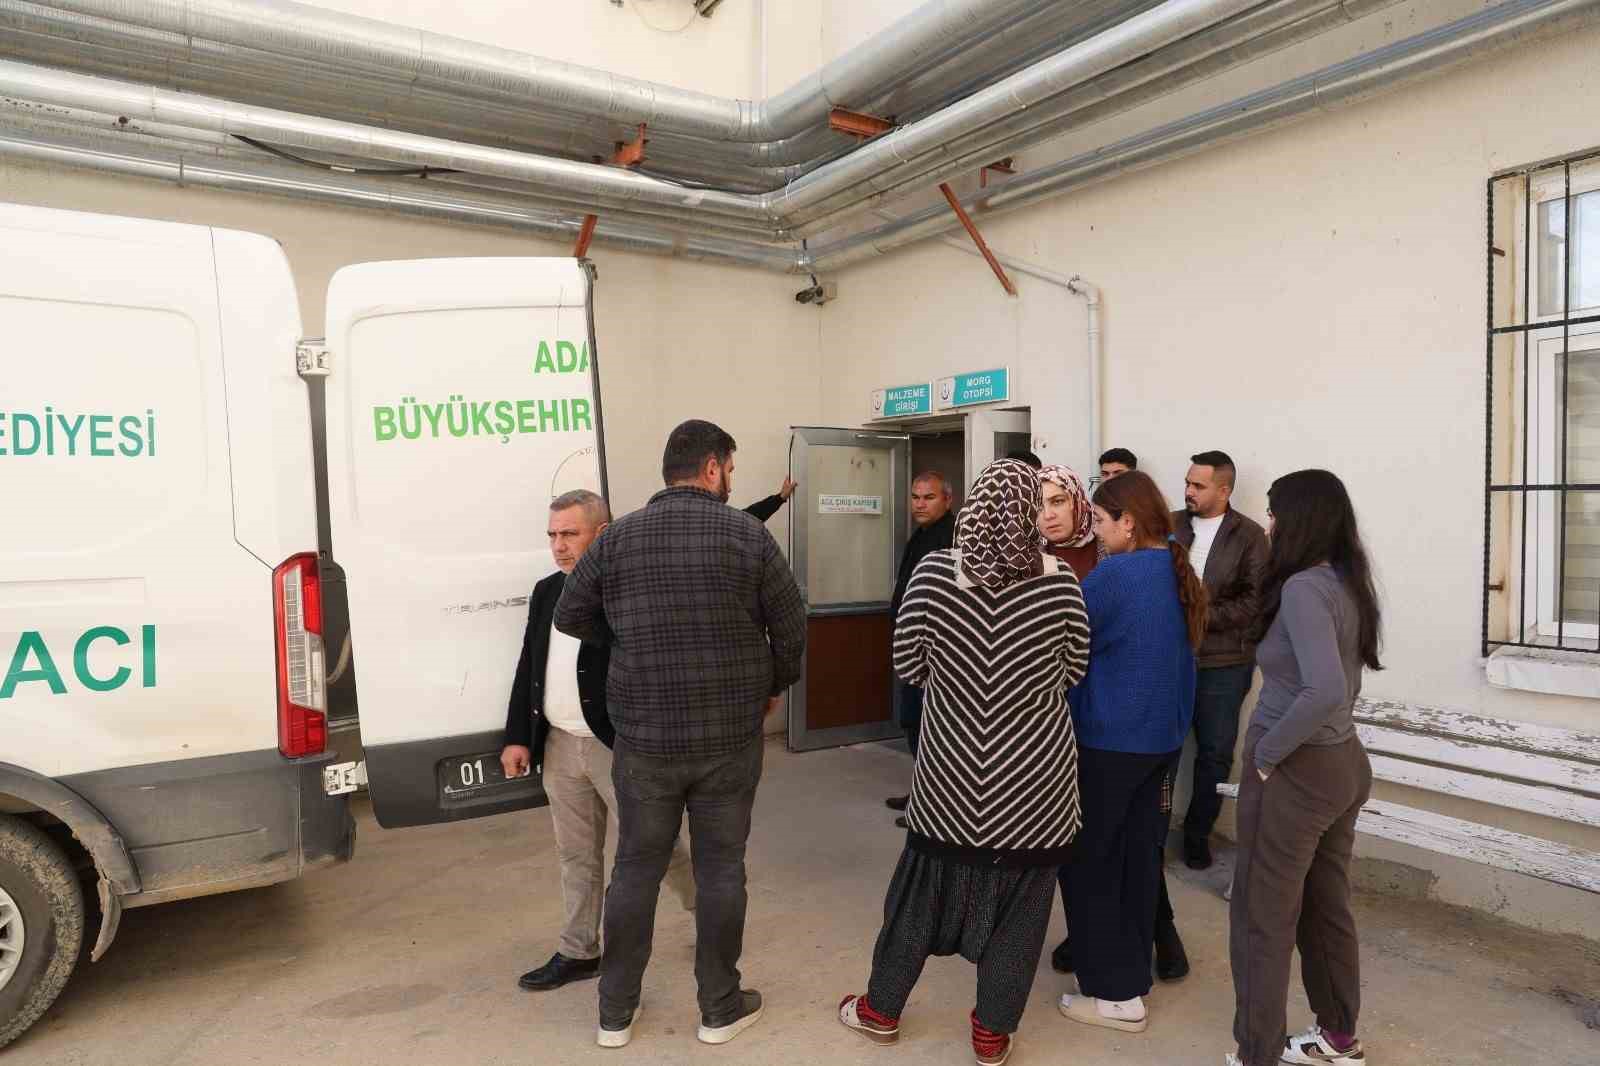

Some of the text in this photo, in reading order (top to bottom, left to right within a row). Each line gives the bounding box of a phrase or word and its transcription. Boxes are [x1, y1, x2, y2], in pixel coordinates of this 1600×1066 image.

[888, 388, 925, 401] MALZEME
[966, 376, 991, 387] MORG
[0, 406, 155, 457] DİYESİ
[0, 624, 156, 699] ACI
[461, 759, 484, 786] 01
